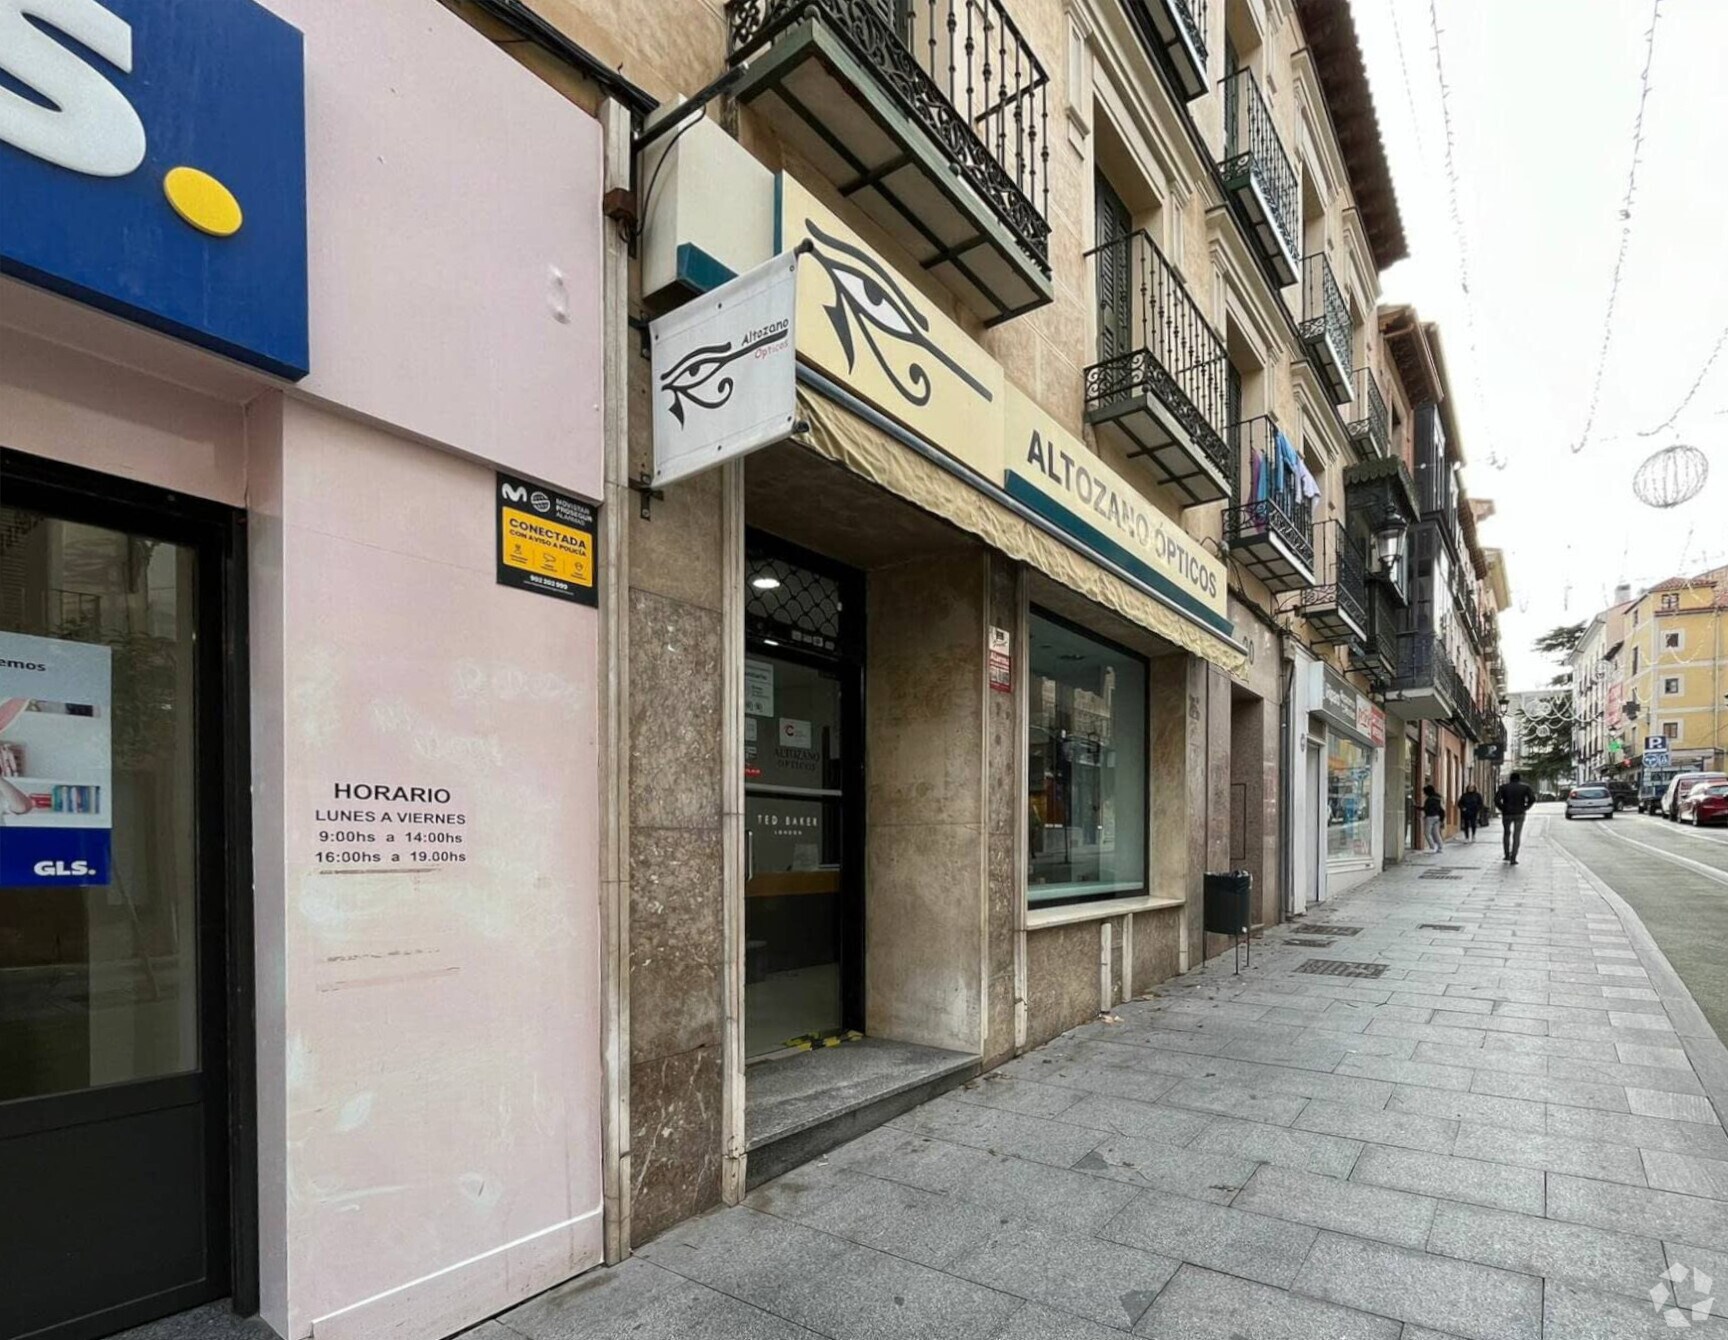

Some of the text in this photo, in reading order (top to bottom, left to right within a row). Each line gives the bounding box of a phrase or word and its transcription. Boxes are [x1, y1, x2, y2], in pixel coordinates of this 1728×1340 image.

[741, 319, 789, 346] Altozano
[556, 498, 590, 514] MOVISTAR
[556, 505, 592, 522] PROSEGUR
[1027, 429, 1217, 599] ALTOZANO ÓPTICOS
[509, 518, 587, 549] CONECTADA
[509, 529, 527, 539] CON
[528, 535, 552, 547] AVISO
[334, 783, 451, 804] HORARIO
[315, 810, 466, 825] LUNES A VIERNES
[757, 814, 818, 827] TED BAKER
[319, 831, 463, 843] 9:00hs a 14:00hs
[315, 851, 381, 863] 16:00hs
[391, 853, 400, 863] a
